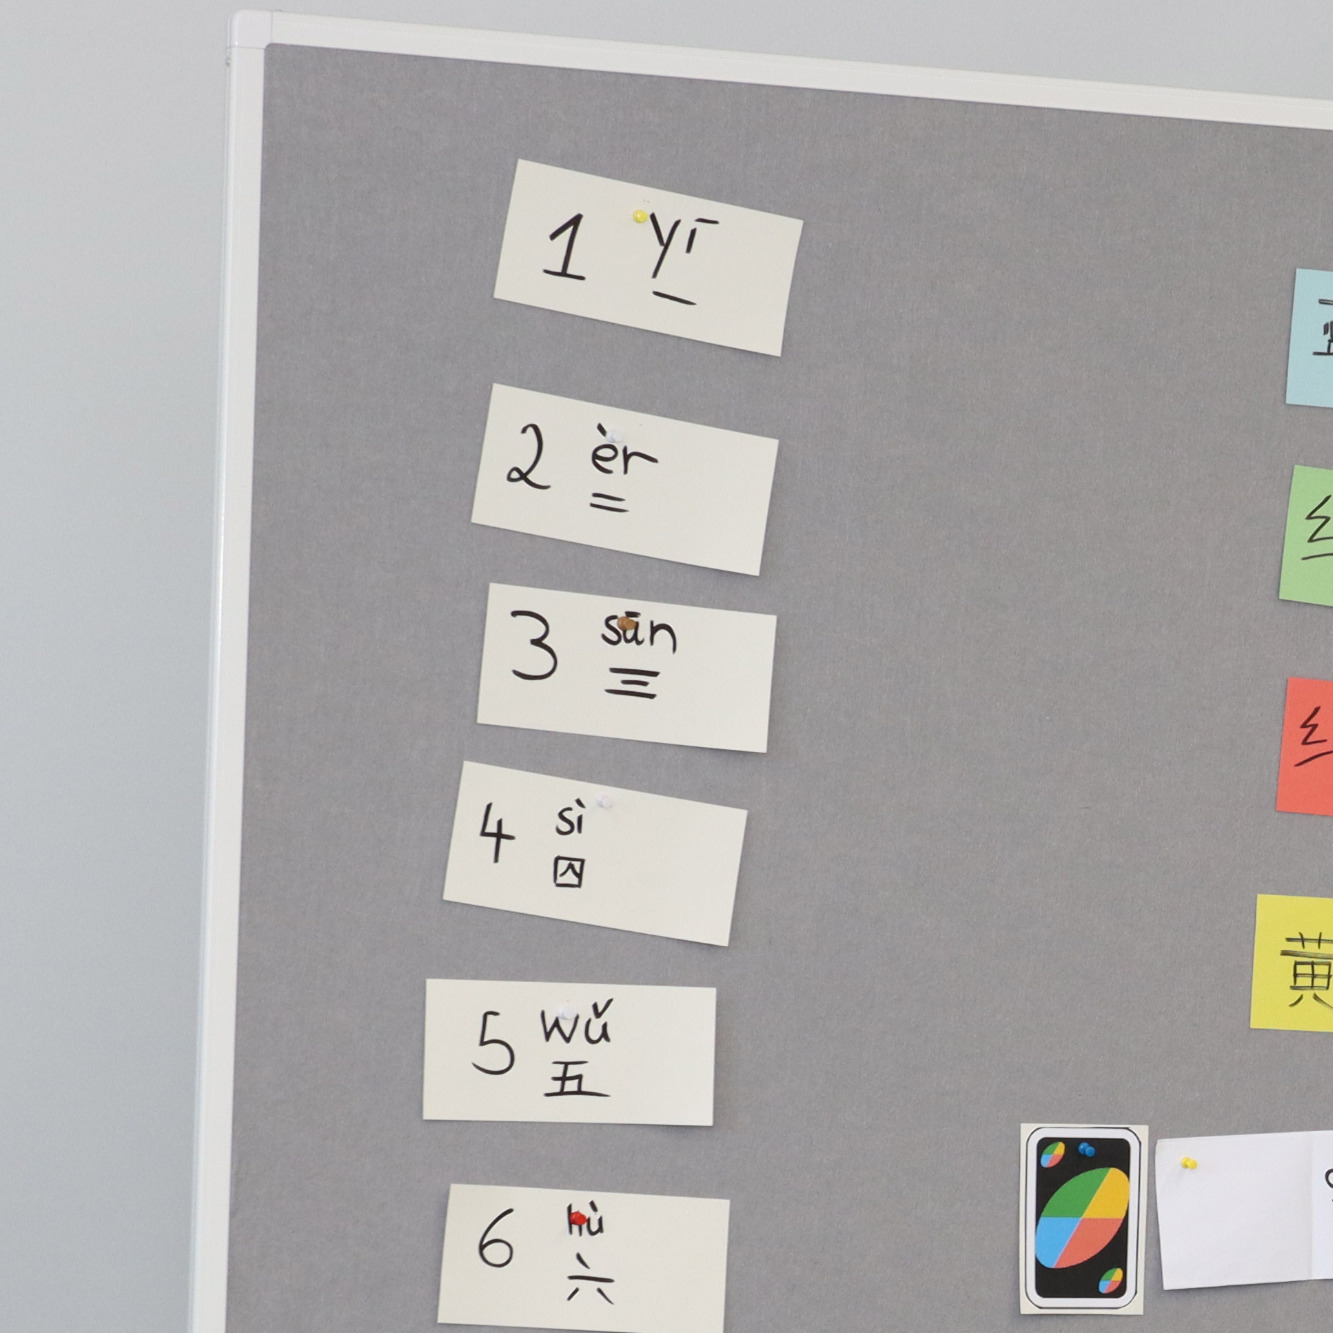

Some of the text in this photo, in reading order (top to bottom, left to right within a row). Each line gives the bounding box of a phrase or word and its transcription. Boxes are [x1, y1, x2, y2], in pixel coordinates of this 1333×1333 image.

[542, 212, 720, 281] 1 yī
[652, 290, 697, 306] 一
[506, 422, 659, 490] 2 èr
[589, 492, 629, 513] 二
[510, 609, 677, 681] 3 sān
[604, 667, 661, 700] 三
[479, 797, 586, 864] 4 sì
[471, 997, 614, 1076] 5 wǔ
[543, 1060, 610, 1098] 五
[478, 1208, 514, 1269] 6
[566, 1252, 615, 1305] 六
